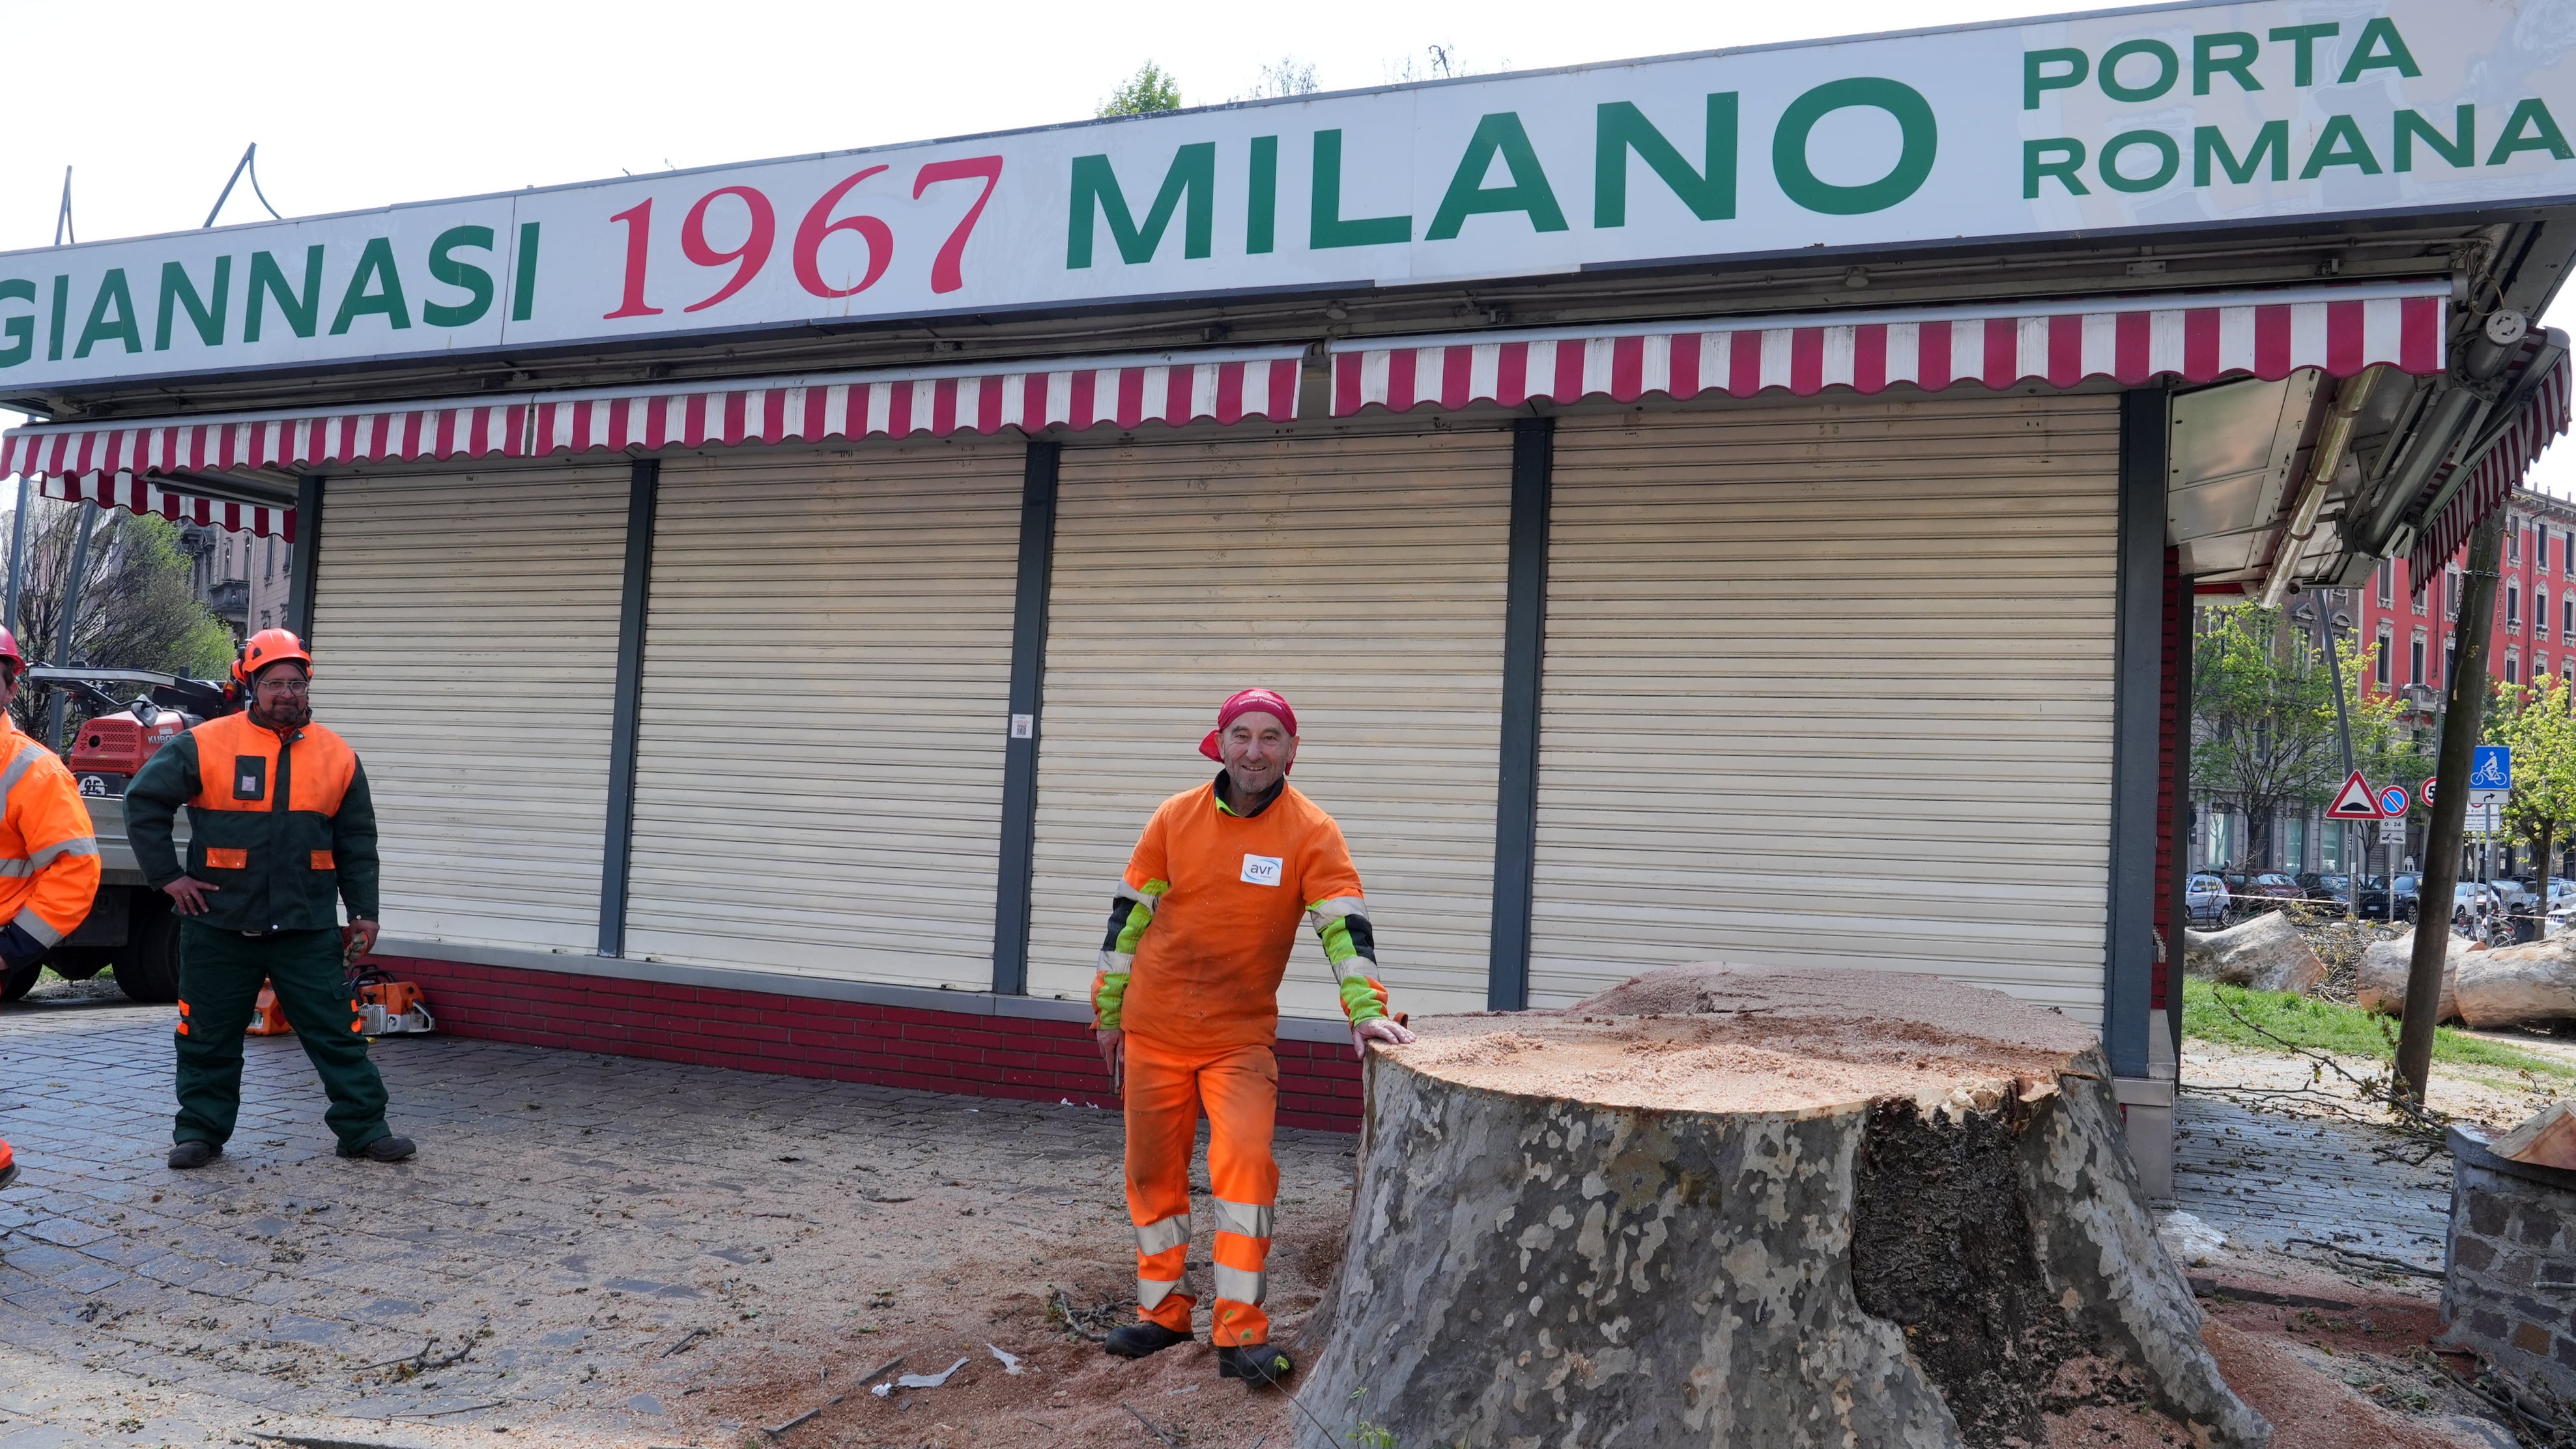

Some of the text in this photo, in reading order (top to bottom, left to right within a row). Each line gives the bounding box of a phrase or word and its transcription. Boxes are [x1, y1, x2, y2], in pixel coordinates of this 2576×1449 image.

[2024, 17, 2422, 111] PORTA
[2023, 98, 2576, 199] ROMANA
[0, 77, 1938, 368] GIANNASI 1967 MILANO
[2428, 786, 2435, 799] 5
[1250, 865, 1273, 875] avr
